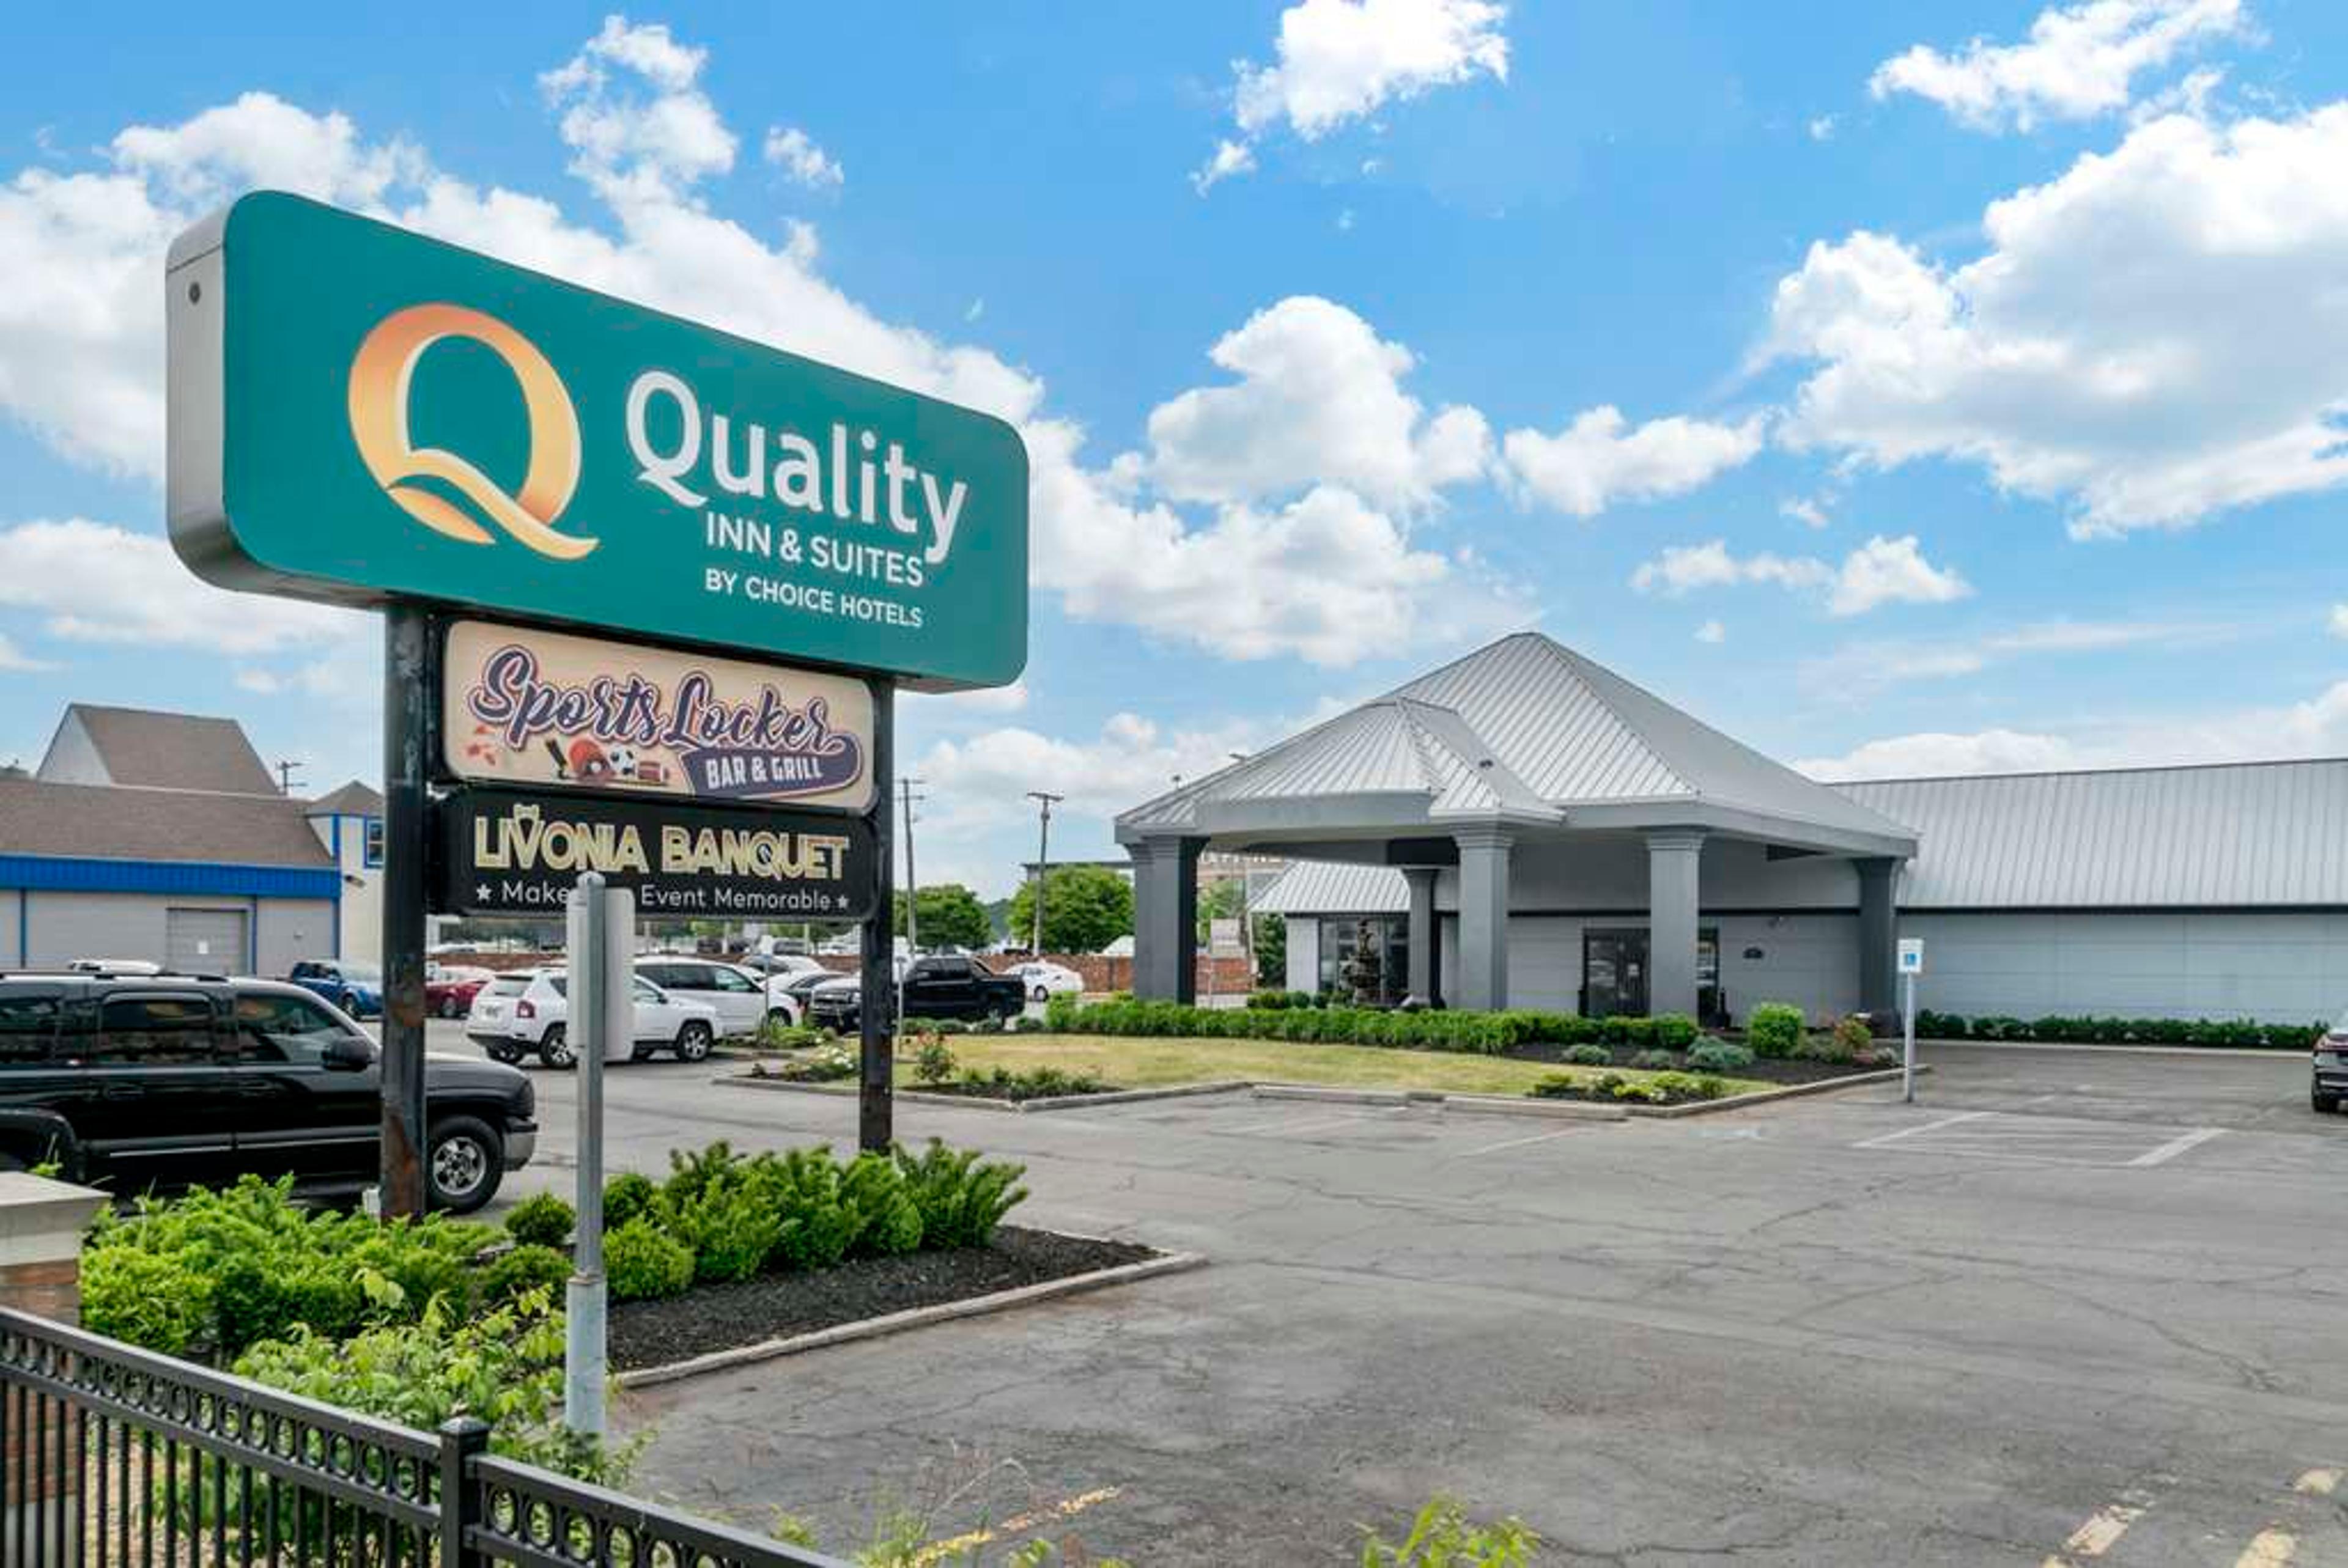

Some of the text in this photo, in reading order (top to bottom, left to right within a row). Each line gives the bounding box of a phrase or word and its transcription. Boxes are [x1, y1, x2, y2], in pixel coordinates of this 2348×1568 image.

[348, 306, 600, 559] Q
[625, 370, 967, 564] Quality
[706, 511, 923, 587] INN & SUITES
[705, 568, 923, 628] BY CHOICE HOTELS
[468, 645, 847, 756] Sports Locker
[705, 753, 824, 789] BAR & GRILL
[474, 803, 850, 881] LIVONIA BANQUET
[501, 880, 831, 910] Make Event Memorable
